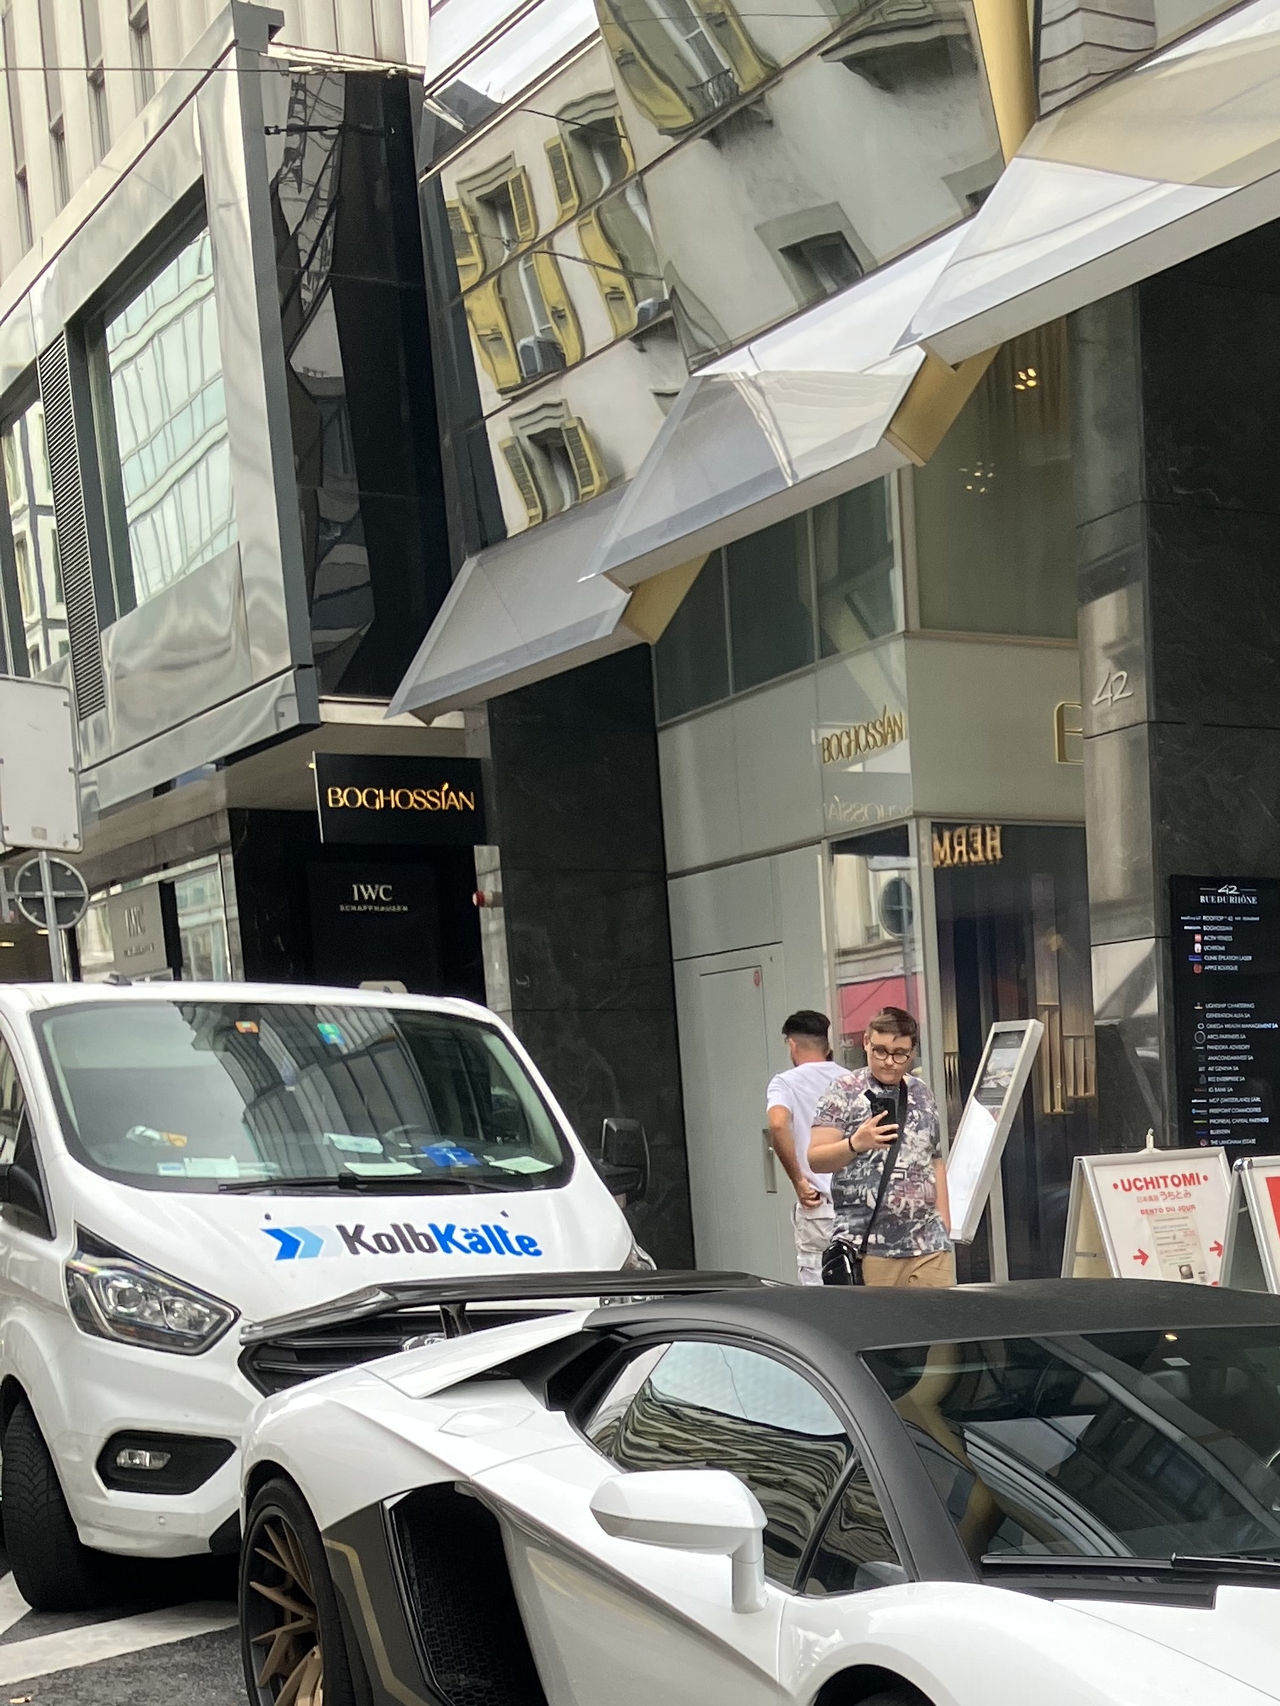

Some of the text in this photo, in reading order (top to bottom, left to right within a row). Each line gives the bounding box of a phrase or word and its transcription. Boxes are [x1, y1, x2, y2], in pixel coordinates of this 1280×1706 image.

[1091, 670, 1134, 707] 42
[352, 884, 393, 901] IWC
[1217, 884, 1241, 895] 42
[1200, 894, 1258, 905] RUE DU RHÔNE
[1120, 1172, 1202, 1192] UCHITOMI
[1140, 1207, 1164, 1215] BENTO
[1177, 1204, 1196, 1212] JOUR
[335, 1223, 543, 1257] KolbKälte
